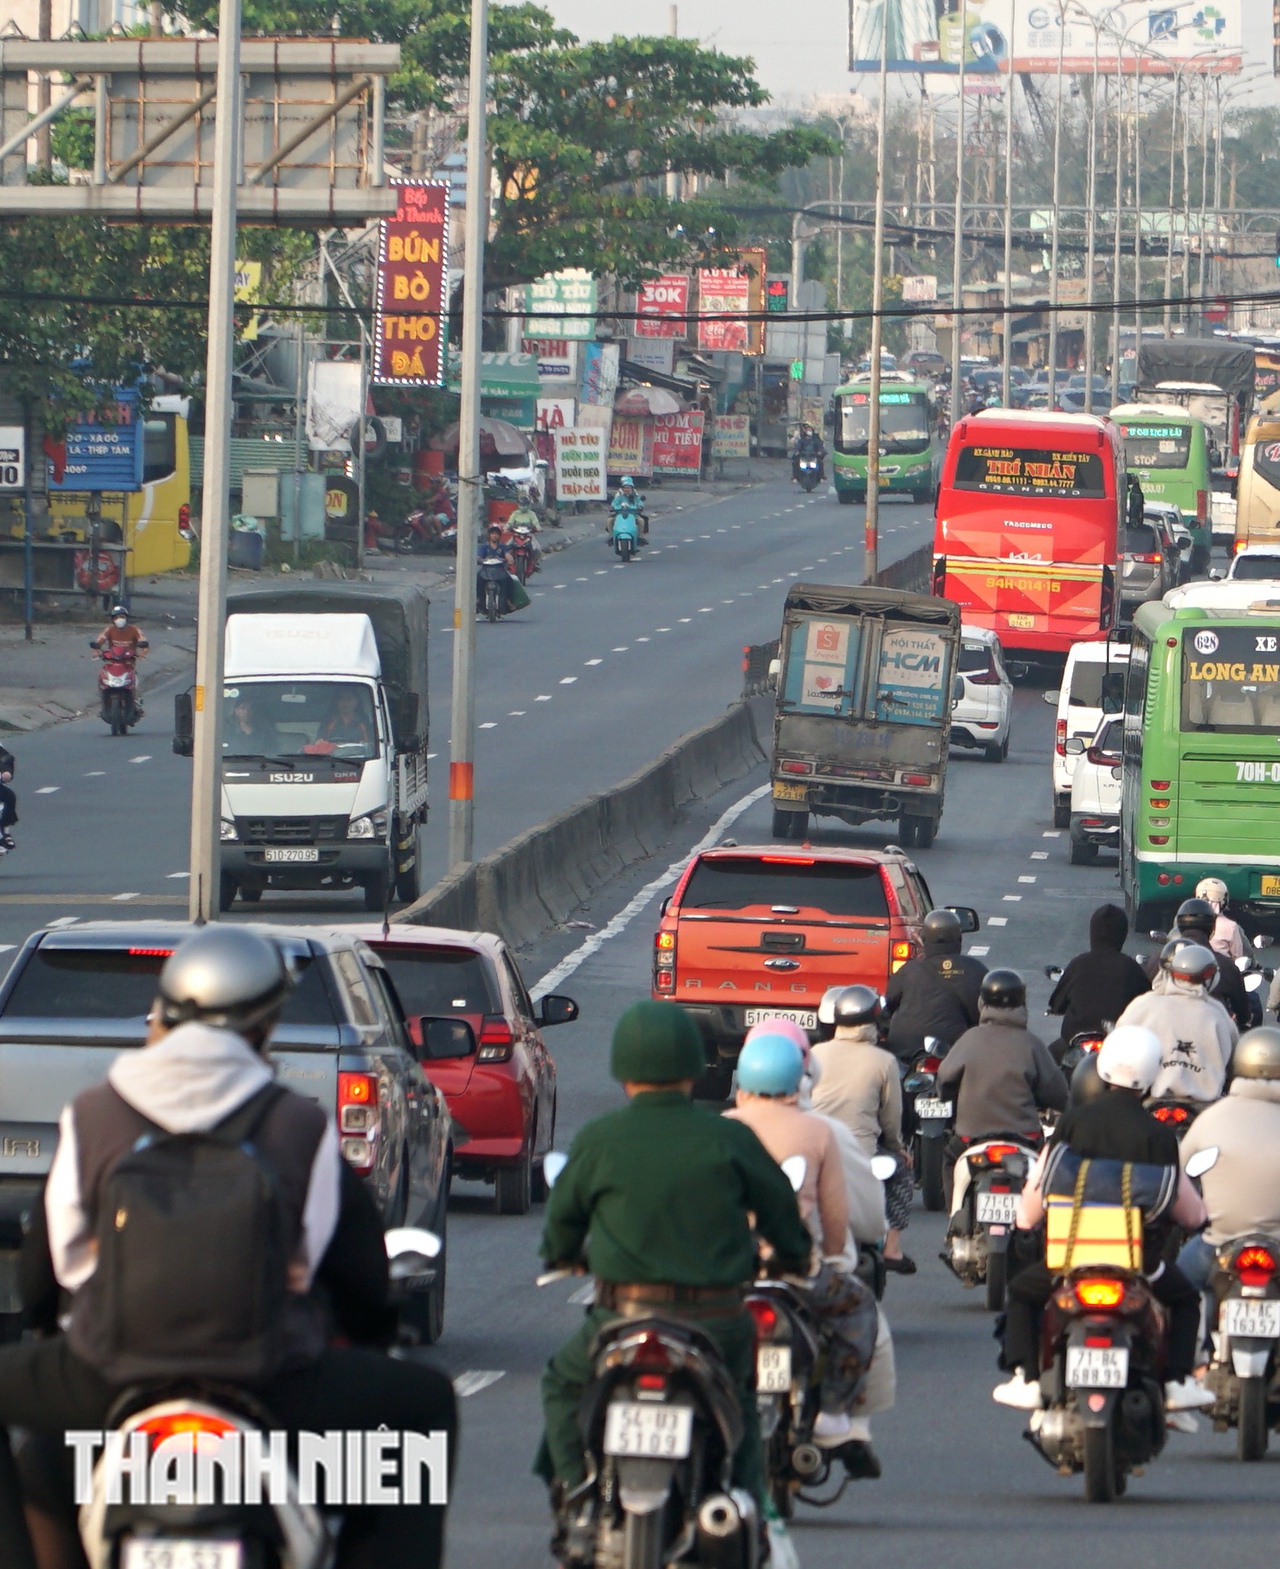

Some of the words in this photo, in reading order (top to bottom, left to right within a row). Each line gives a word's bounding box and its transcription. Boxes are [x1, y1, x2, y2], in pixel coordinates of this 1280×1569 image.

[388, 230, 440, 264] BÚN
[393, 269, 431, 301] BÒ
[642, 287, 682, 303] 30K
[391, 346, 426, 377] ĐÁ
[986, 457, 1021, 476] TRÍ
[1024, 460, 1077, 480] NHÂN
[891, 637, 909, 650] NỘI
[911, 638, 937, 651] THẤT
[1196, 635, 1218, 650] 628
[1255, 636, 1277, 652] XE
[880, 651, 941, 673] HCM
[1190, 662, 1246, 682] LONG
[1250, 664, 1280, 682] AN
[269, 773, 315, 783] ISUZU
[984, 1195, 1015, 1208] 71-C1
[1234, 1302, 1274, 1318] 71-AC
[1232, 1318, 1277, 1335] 163.57
